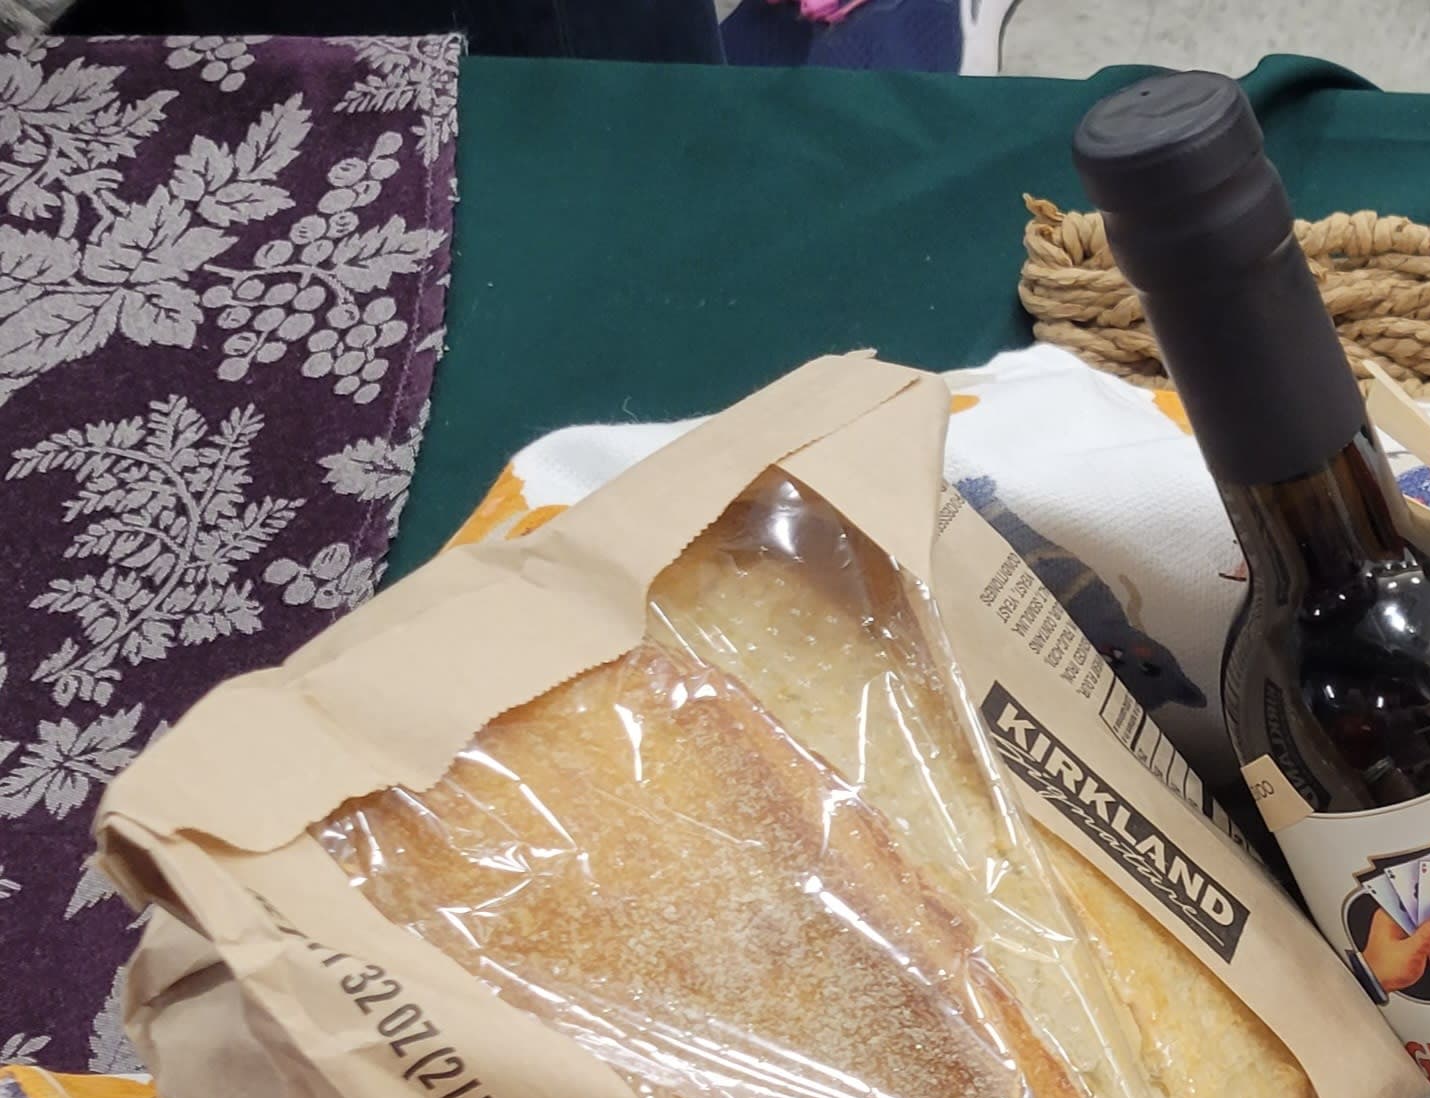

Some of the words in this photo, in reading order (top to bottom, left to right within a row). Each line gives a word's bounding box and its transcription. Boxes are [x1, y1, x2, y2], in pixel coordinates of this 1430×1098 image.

[997, 703, 1235, 926] KIRKLAND
[340, 964, 403, 1015] 32
[377, 1003, 440, 1068] OZ
[402, 1046, 465, 1091] (2
